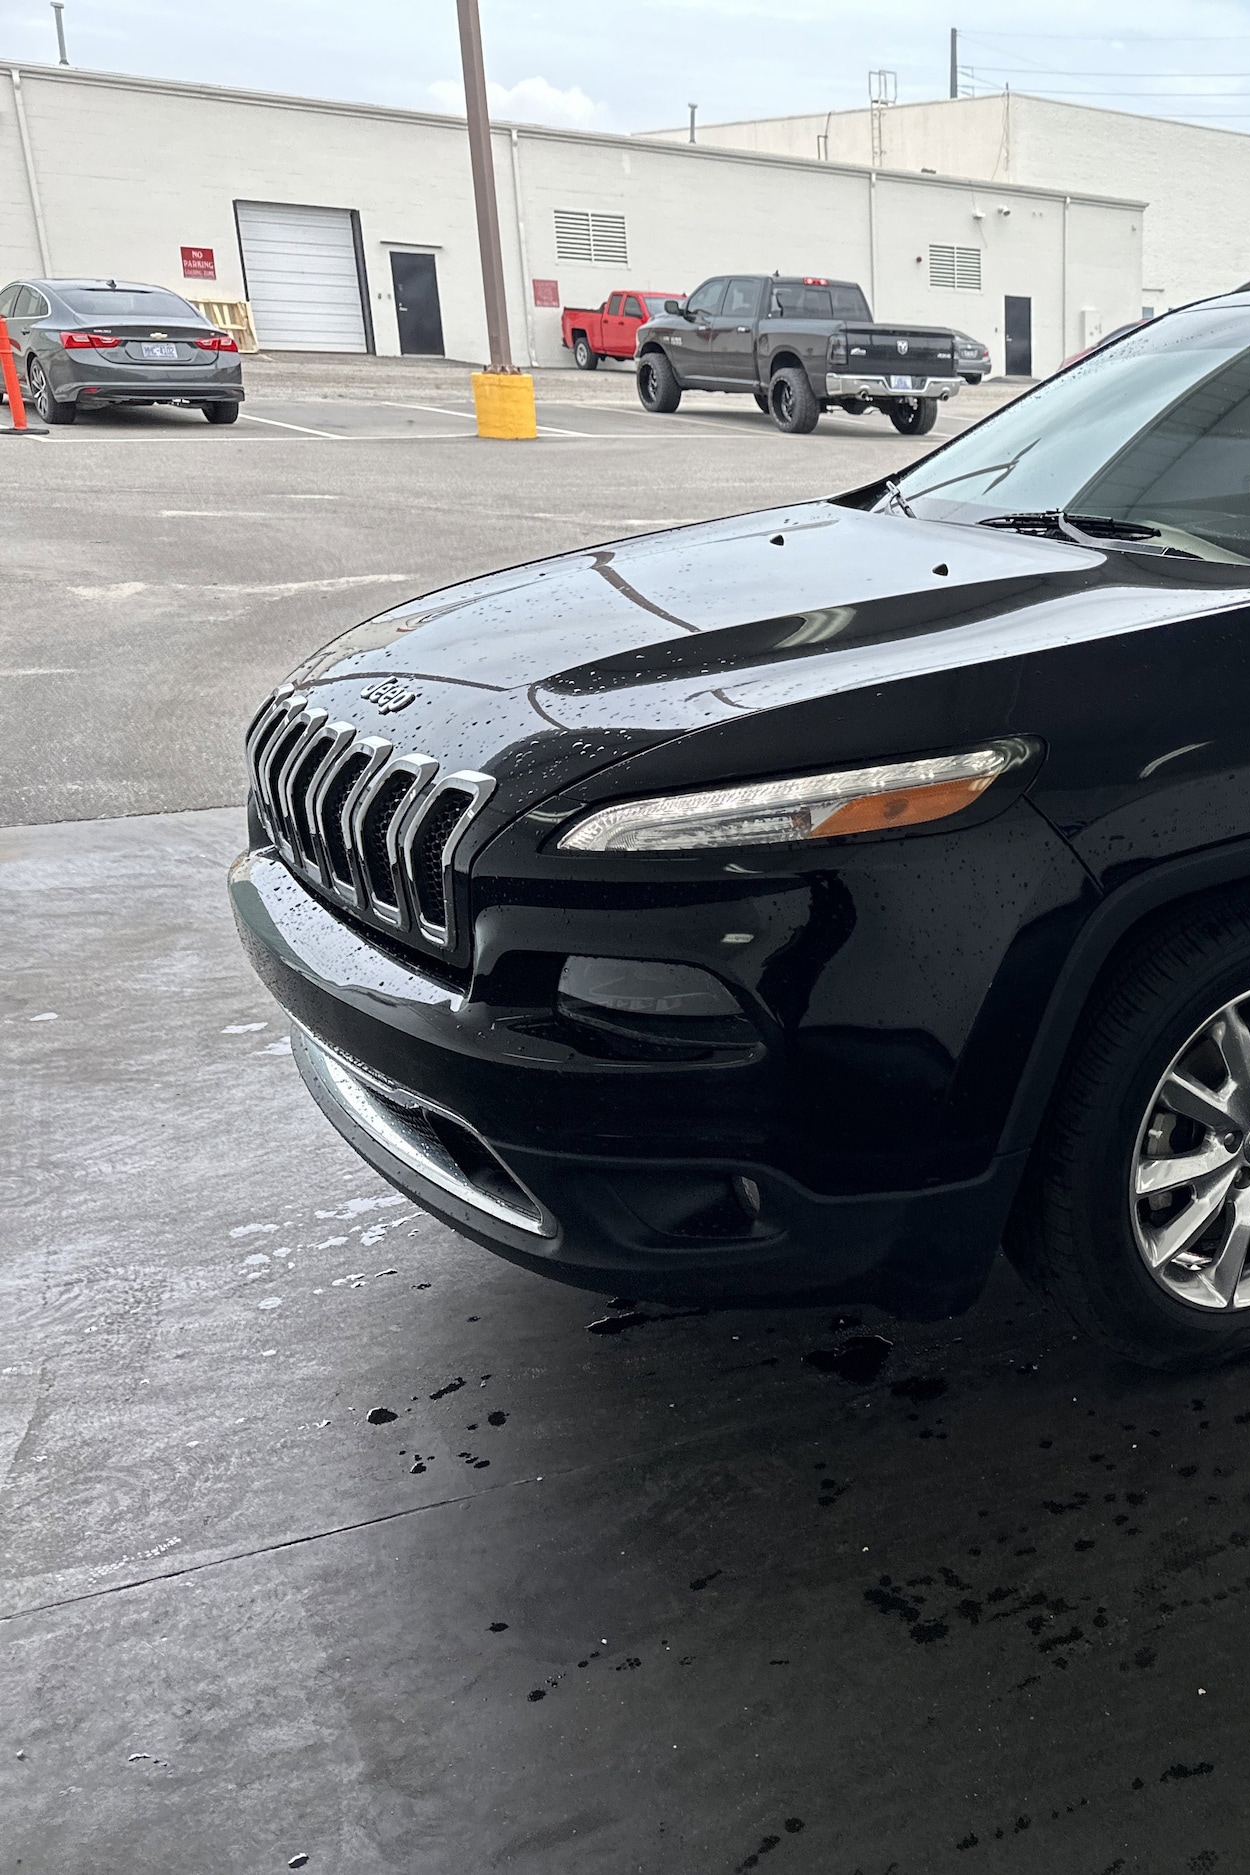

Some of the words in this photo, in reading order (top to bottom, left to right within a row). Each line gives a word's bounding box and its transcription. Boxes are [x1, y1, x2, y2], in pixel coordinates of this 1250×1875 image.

[191, 250, 203, 259] NO
[183, 260, 214, 269] PARKING
[360, 676, 416, 716] Jeep
